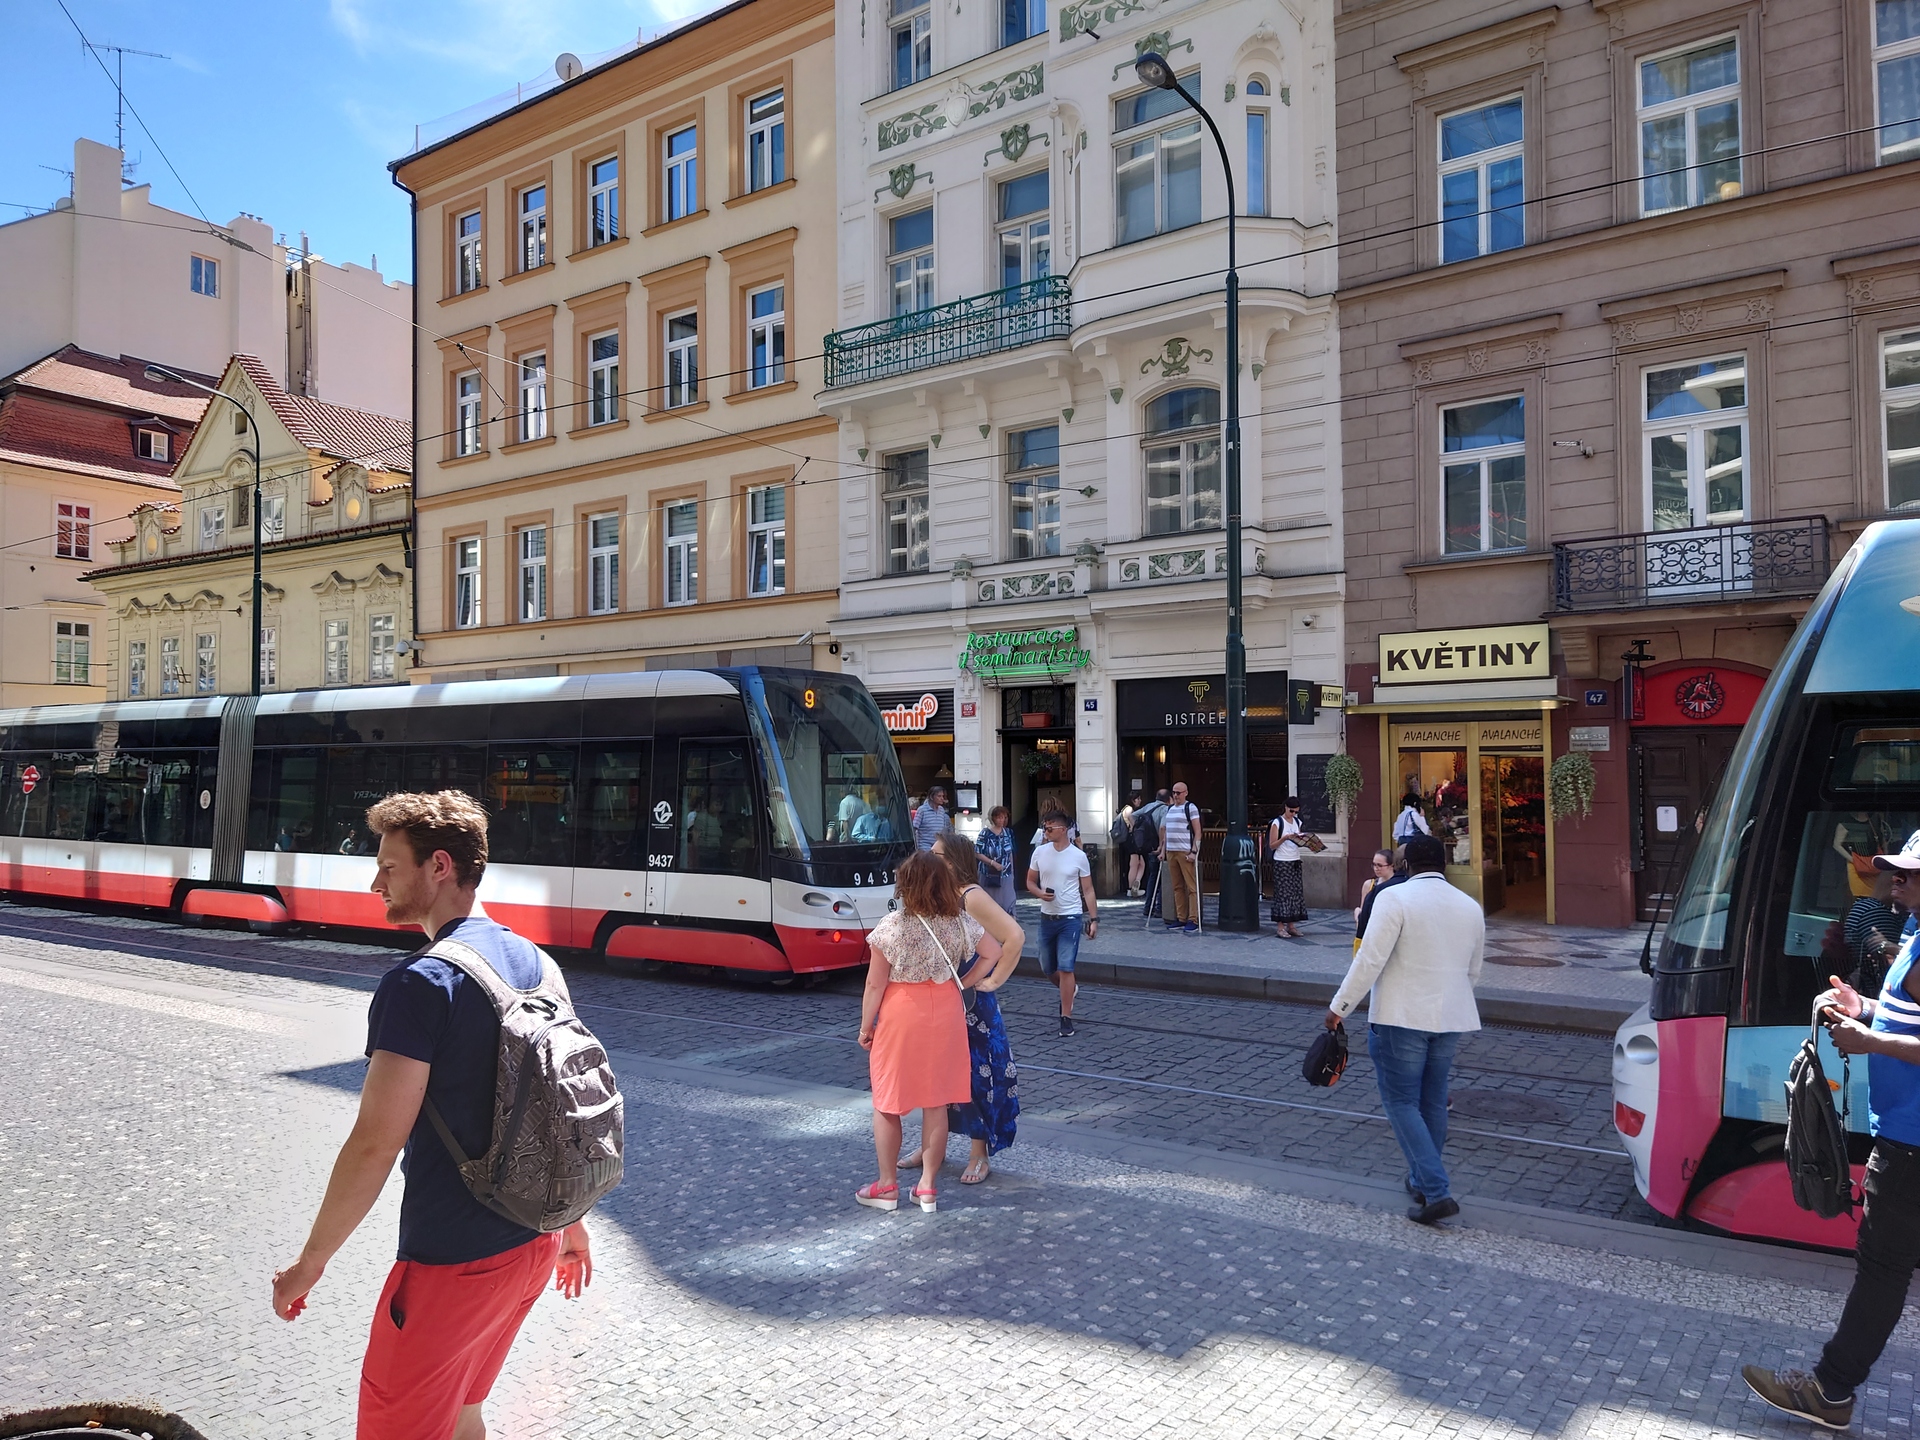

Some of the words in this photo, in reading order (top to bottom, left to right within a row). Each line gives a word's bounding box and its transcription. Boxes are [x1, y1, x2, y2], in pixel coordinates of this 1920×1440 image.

[966, 629, 1075, 650] Restaurace
[973, 644, 1091, 668] seminaristy
[1387, 641, 1541, 672] KVĚTINY
[804, 689, 815, 709] 9
[1085, 701, 1095, 709] 45
[1589, 693, 1604, 704] 47
[881, 705, 927, 729] minit
[1403, 730, 1461, 742] AVALANCHE
[1481, 728, 1541, 741] AVALANCHE
[648, 854, 674, 868] 9437
